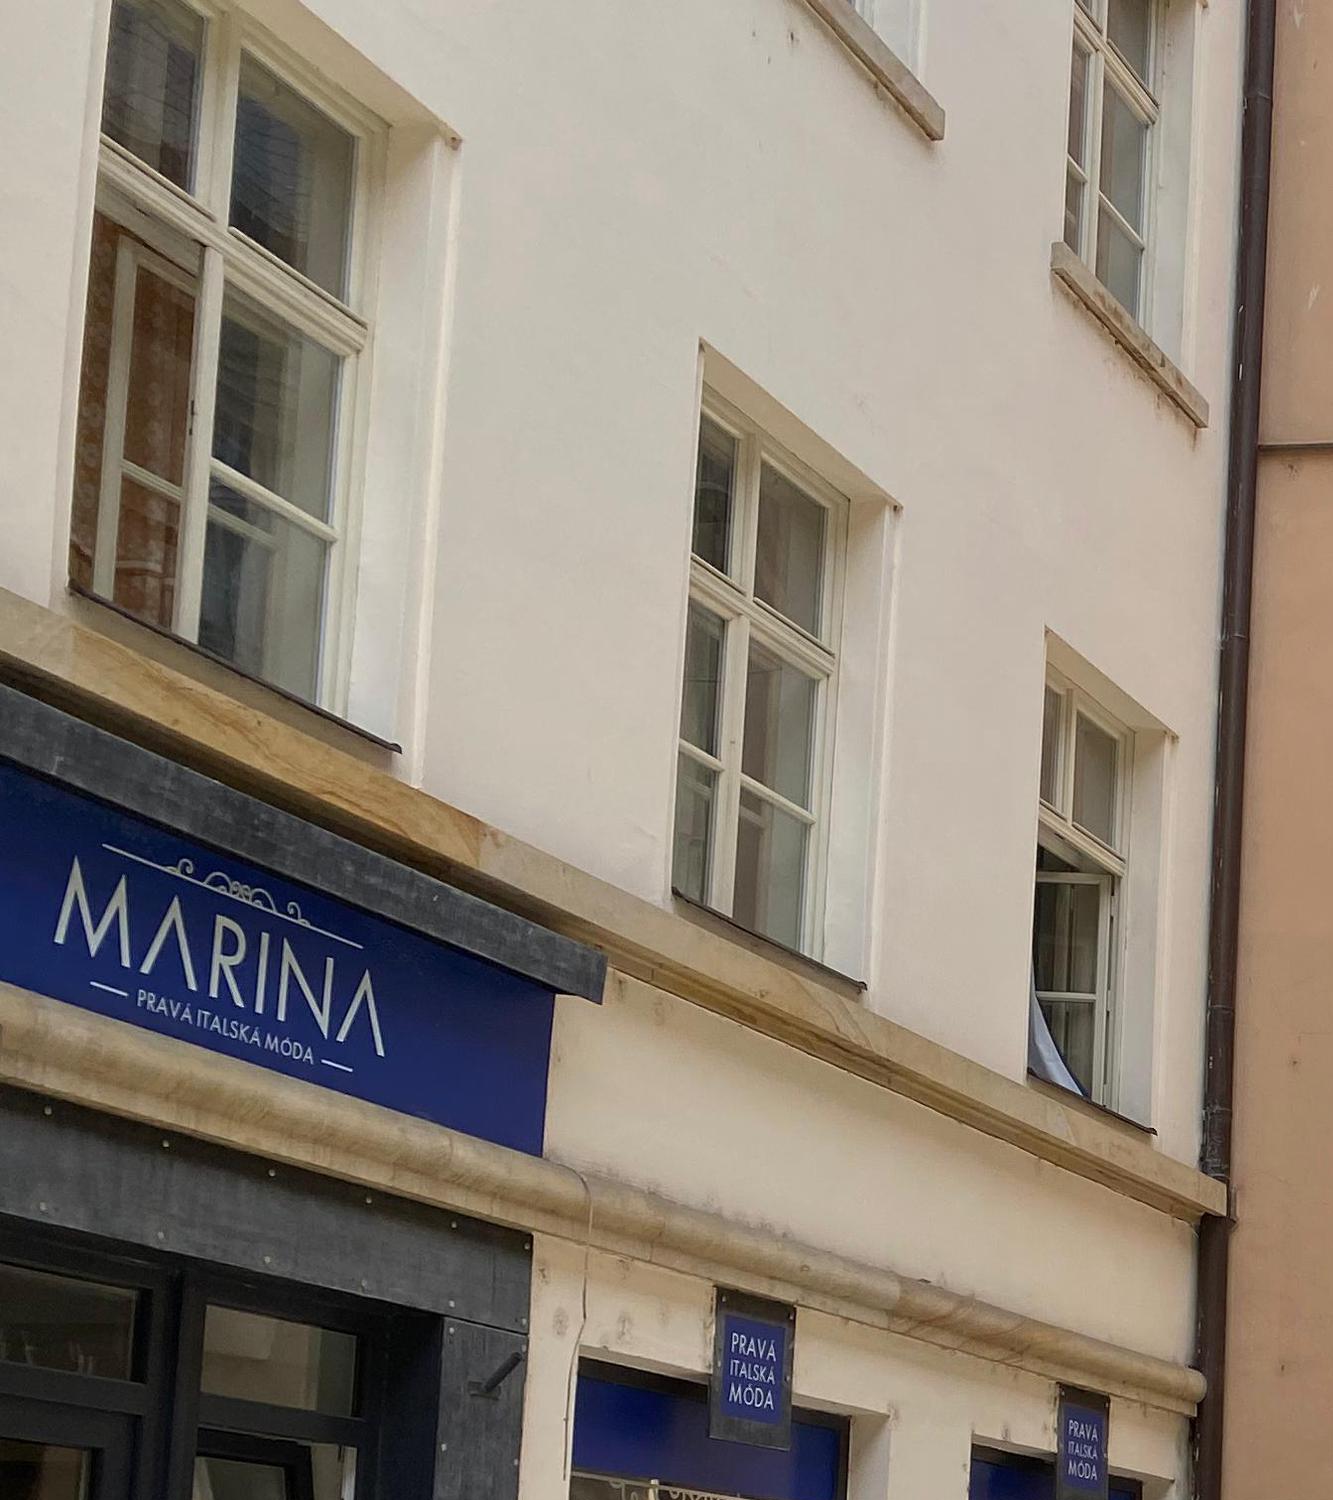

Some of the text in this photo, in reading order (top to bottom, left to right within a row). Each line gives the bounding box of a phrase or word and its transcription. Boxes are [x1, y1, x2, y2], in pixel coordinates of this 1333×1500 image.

[53, 854, 387, 1057] MARINA
[137, 989, 315, 1065] PRAVÁ ITALSKÁ MÓDA
[731, 1332, 776, 1363] PRAVÁ
[729, 1359, 776, 1385] ITALSKÁ
[728, 1382, 774, 1411] MÓDA
[1068, 1419, 1099, 1442] PRAVÁ
[1067, 1440, 1099, 1460] ITALSKÁ
[1067, 1459, 1098, 1481] MÓDA
